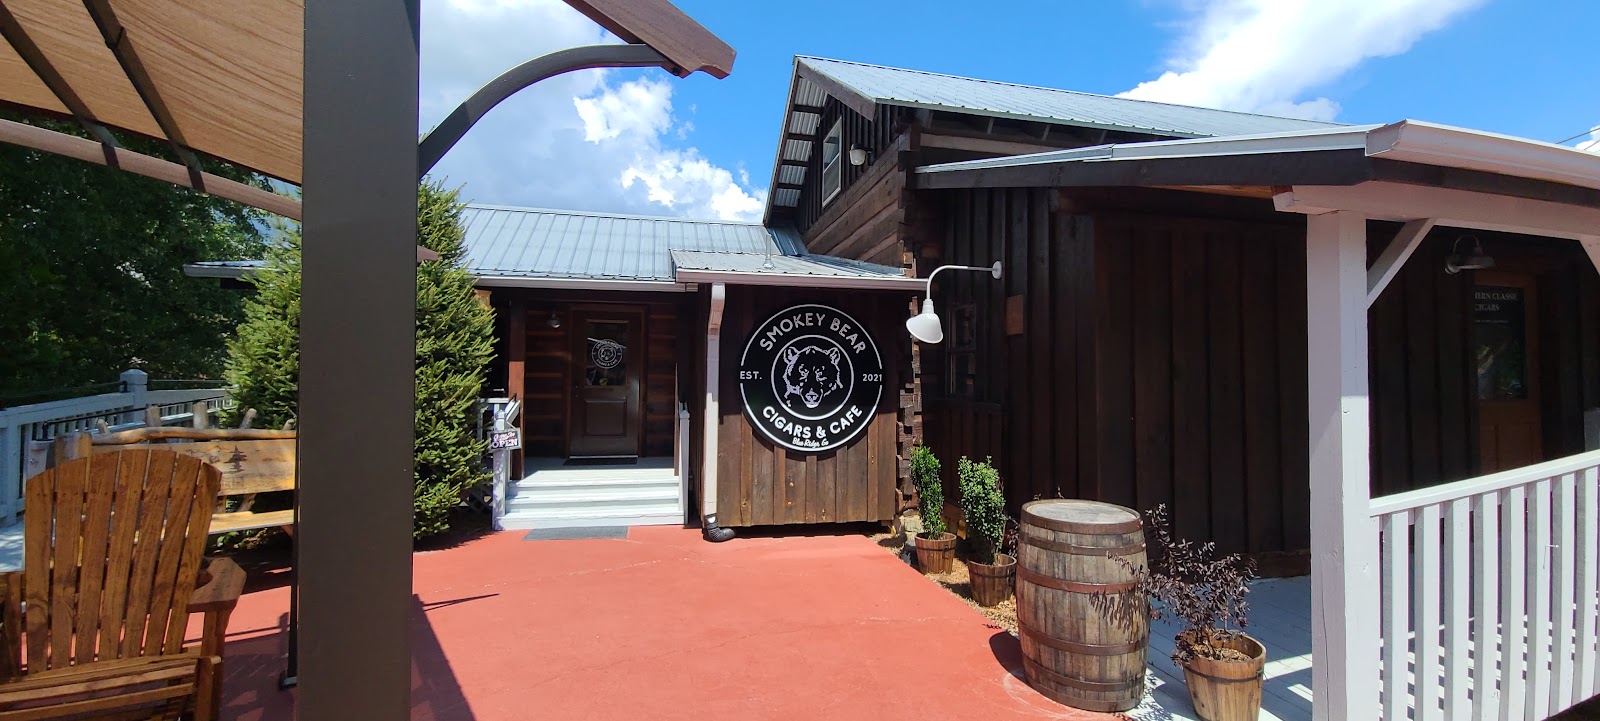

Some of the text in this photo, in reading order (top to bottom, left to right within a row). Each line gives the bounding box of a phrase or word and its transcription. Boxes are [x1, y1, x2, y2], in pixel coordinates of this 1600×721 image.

[759, 313, 866, 354] SMOKEY BEAR
[739, 371, 762, 380] EST.
[862, 373, 883, 382] 2021
[762, 404, 863, 439] CIGARS & CAFE
[491, 439, 517, 448] OPEN
